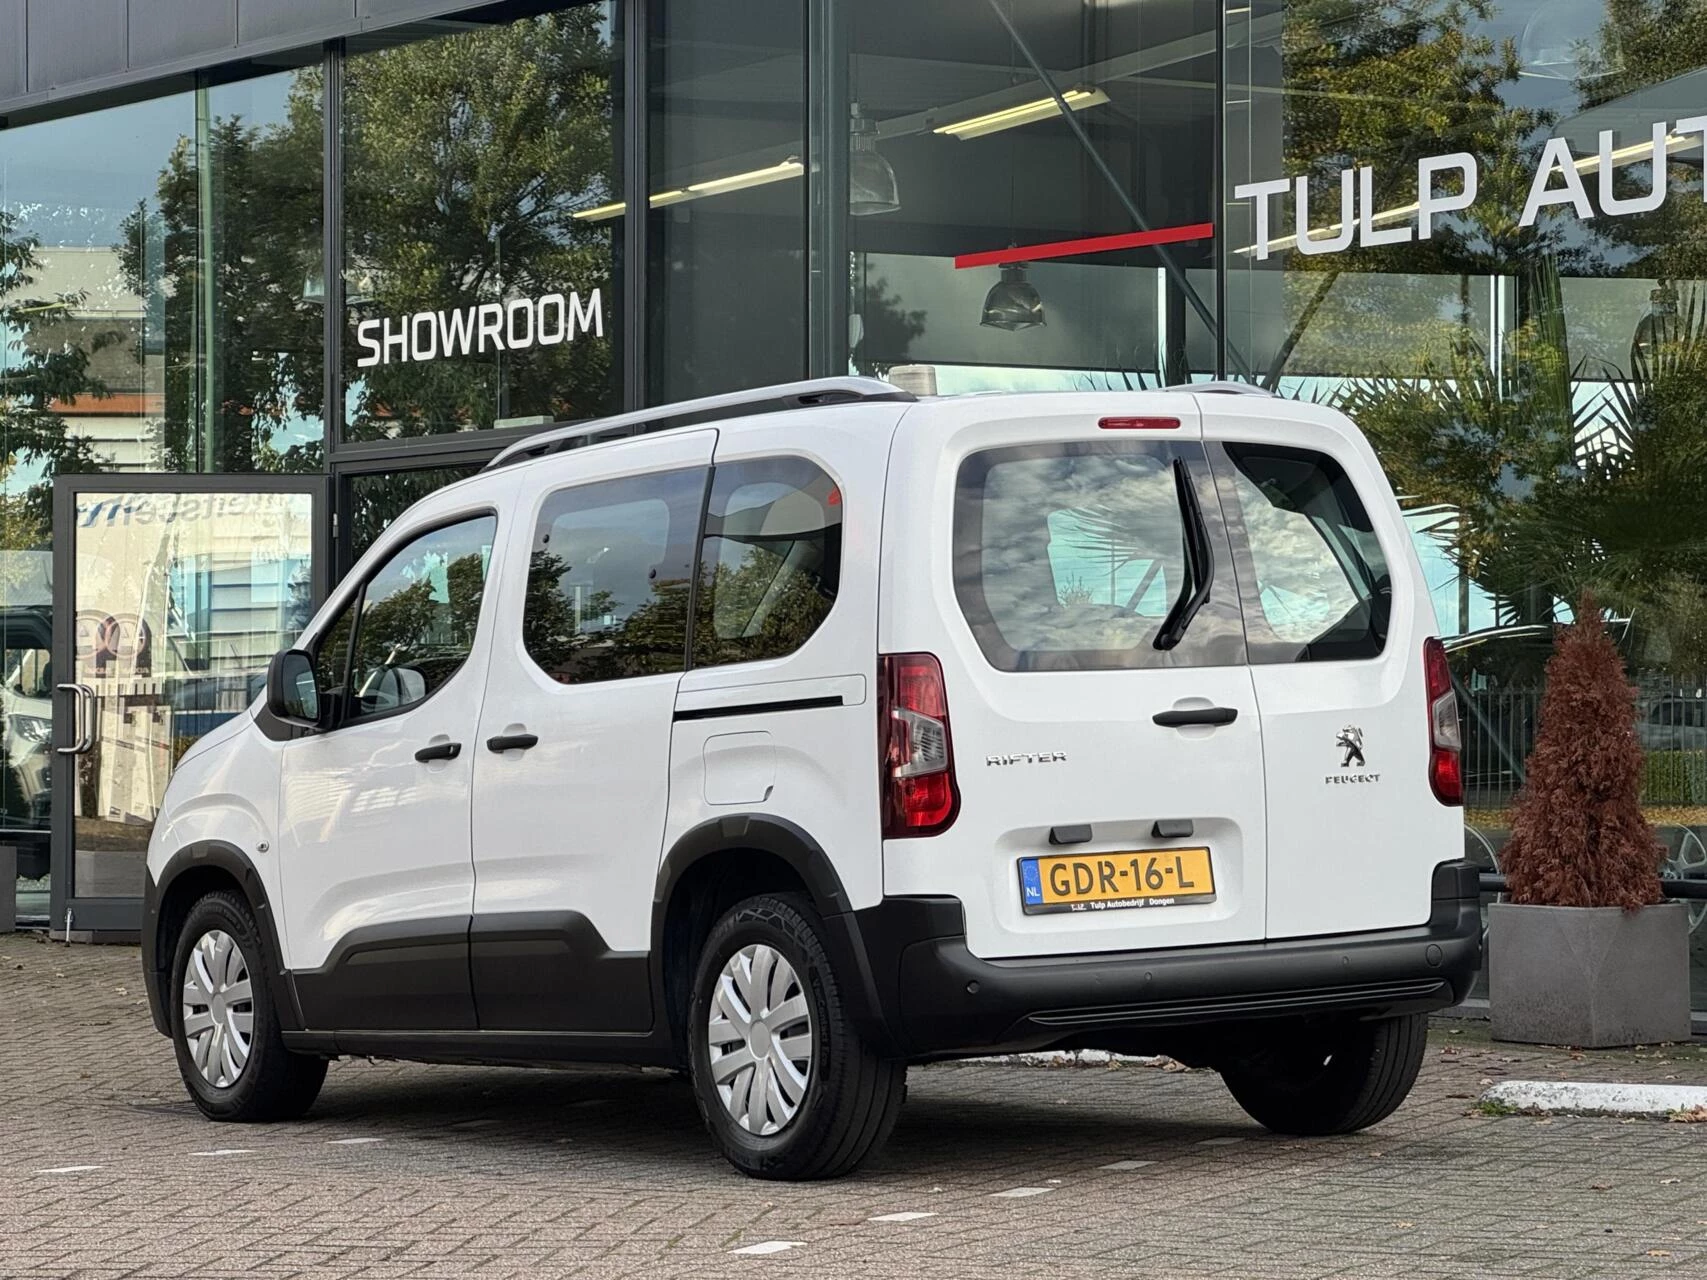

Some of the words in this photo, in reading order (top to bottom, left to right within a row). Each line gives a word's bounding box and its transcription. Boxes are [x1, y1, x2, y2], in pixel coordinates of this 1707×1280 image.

[1234, 152, 1478, 261] TULP
[357, 288, 604, 367] SHOWROOM
[986, 752, 1067, 766] RIFTER
[1325, 774, 1380, 784] PEUGEOT
[1049, 856, 1195, 896] GDR-16-L
[1026, 887, 1040, 897] NL
[1090, 901, 1106, 910] Tulp
[1107, 898, 1144, 908] Autobedrijf
[1149, 898, 1175, 906] Dongen
